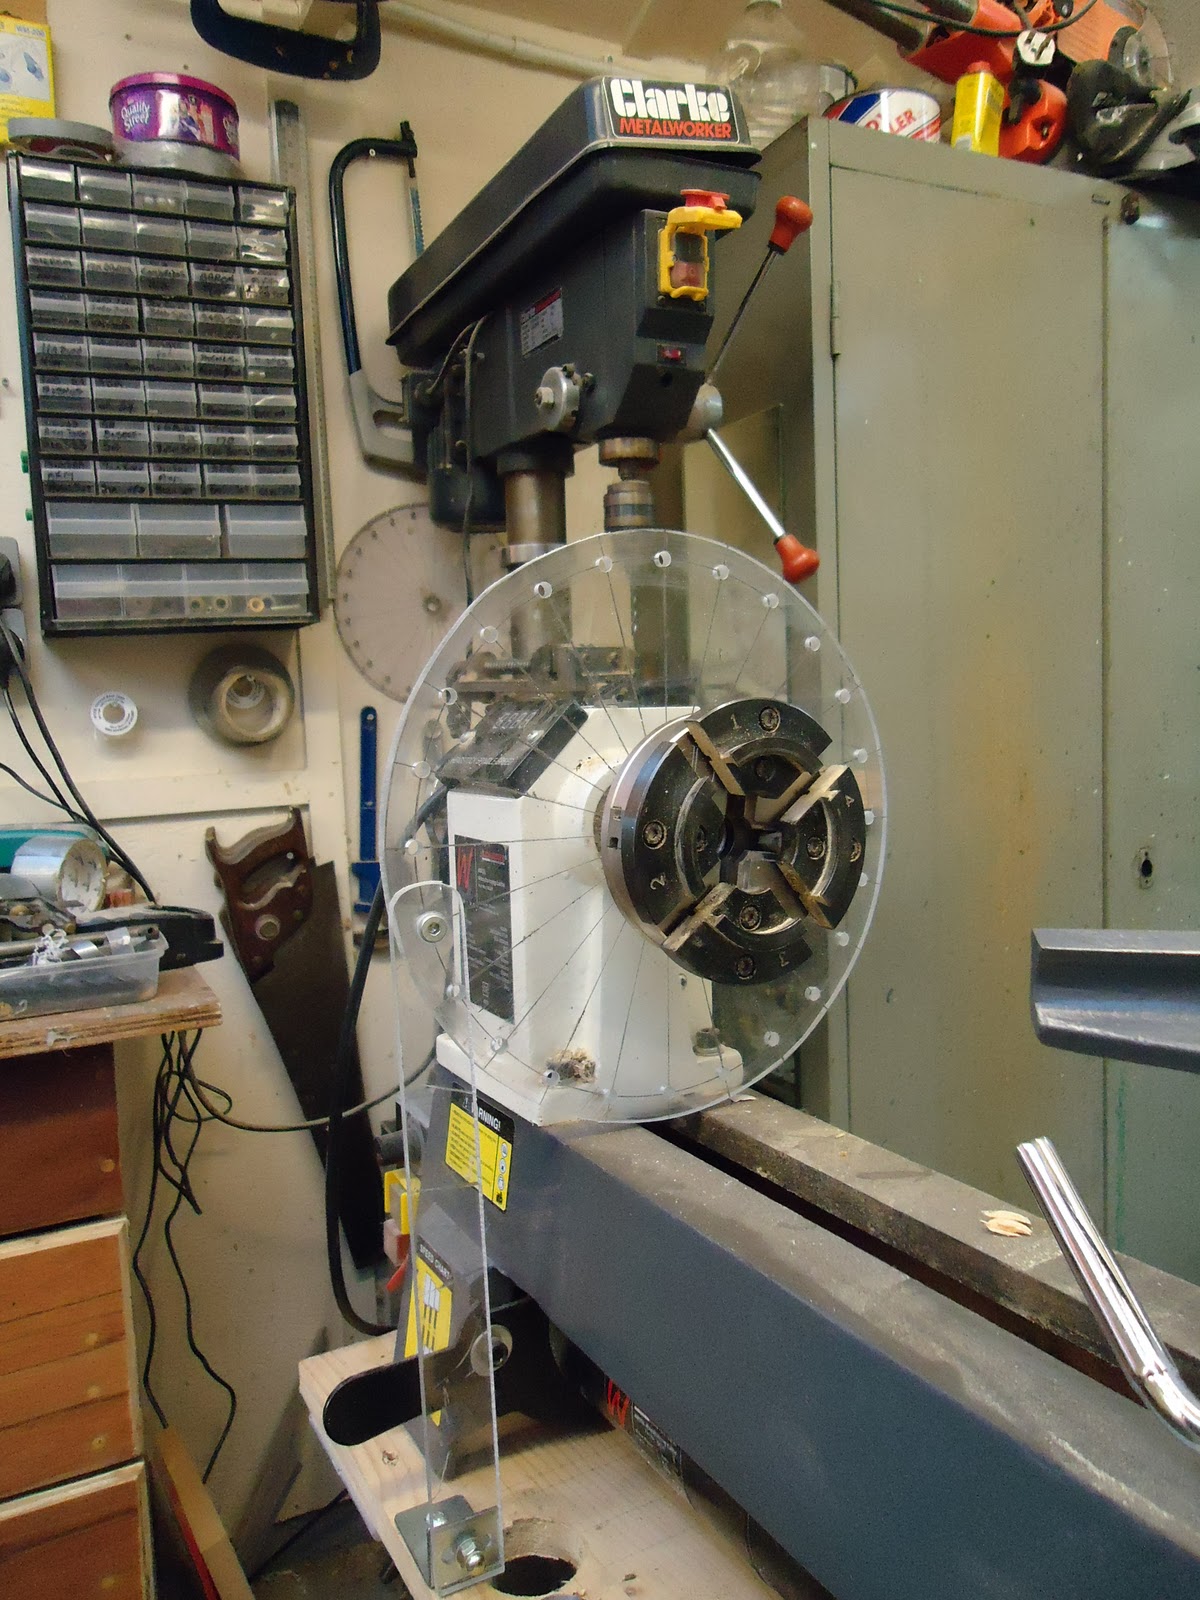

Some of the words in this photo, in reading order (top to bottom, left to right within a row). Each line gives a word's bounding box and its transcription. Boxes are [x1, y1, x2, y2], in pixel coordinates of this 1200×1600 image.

[121, 100, 150, 120] Quality
[610, 78, 730, 122] Clarke
[619, 117, 732, 138] METALWORKER
[731, 714, 742, 730] 1
[650, 871, 667, 891] 2
[471, 1102, 501, 1132] RNING!
